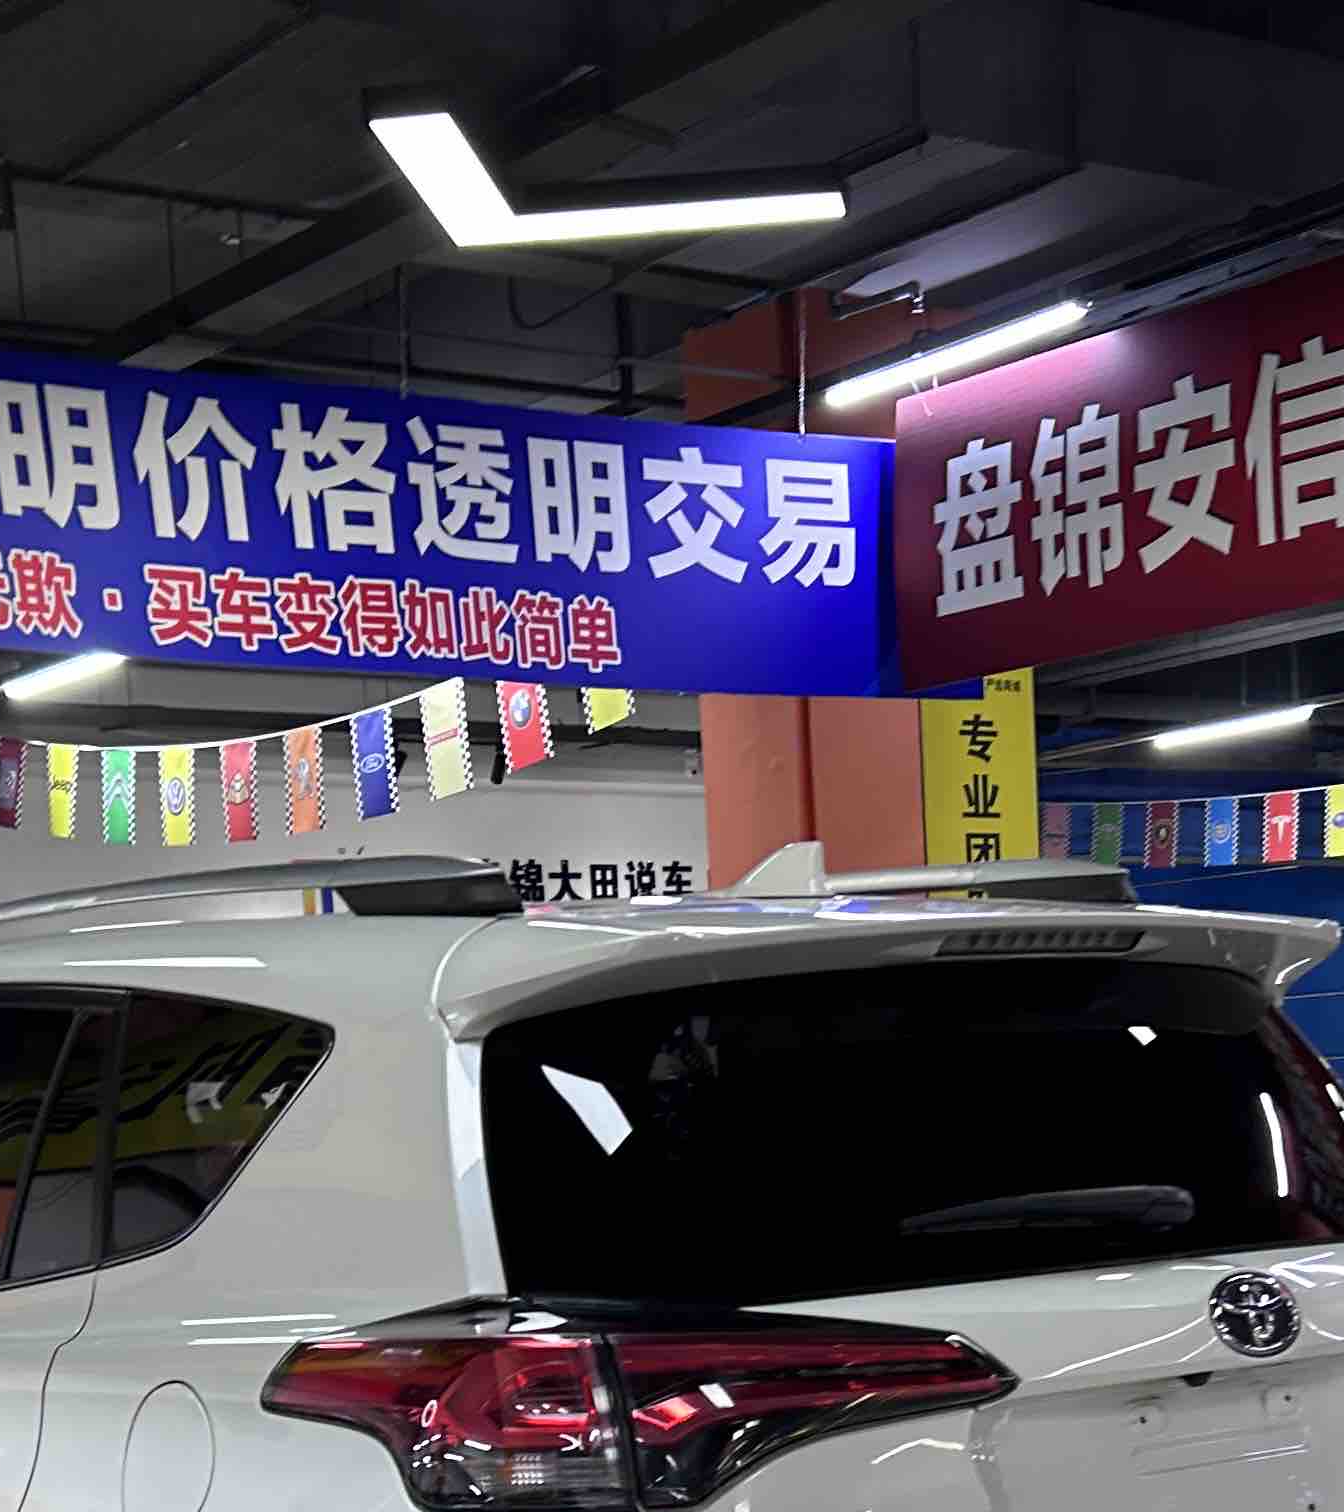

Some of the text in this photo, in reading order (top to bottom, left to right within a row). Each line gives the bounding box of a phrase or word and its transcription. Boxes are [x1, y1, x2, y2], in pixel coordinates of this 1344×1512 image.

[958, 713, 1001, 864] 专业团
[482, 858, 694, 902] 锦大田说车
